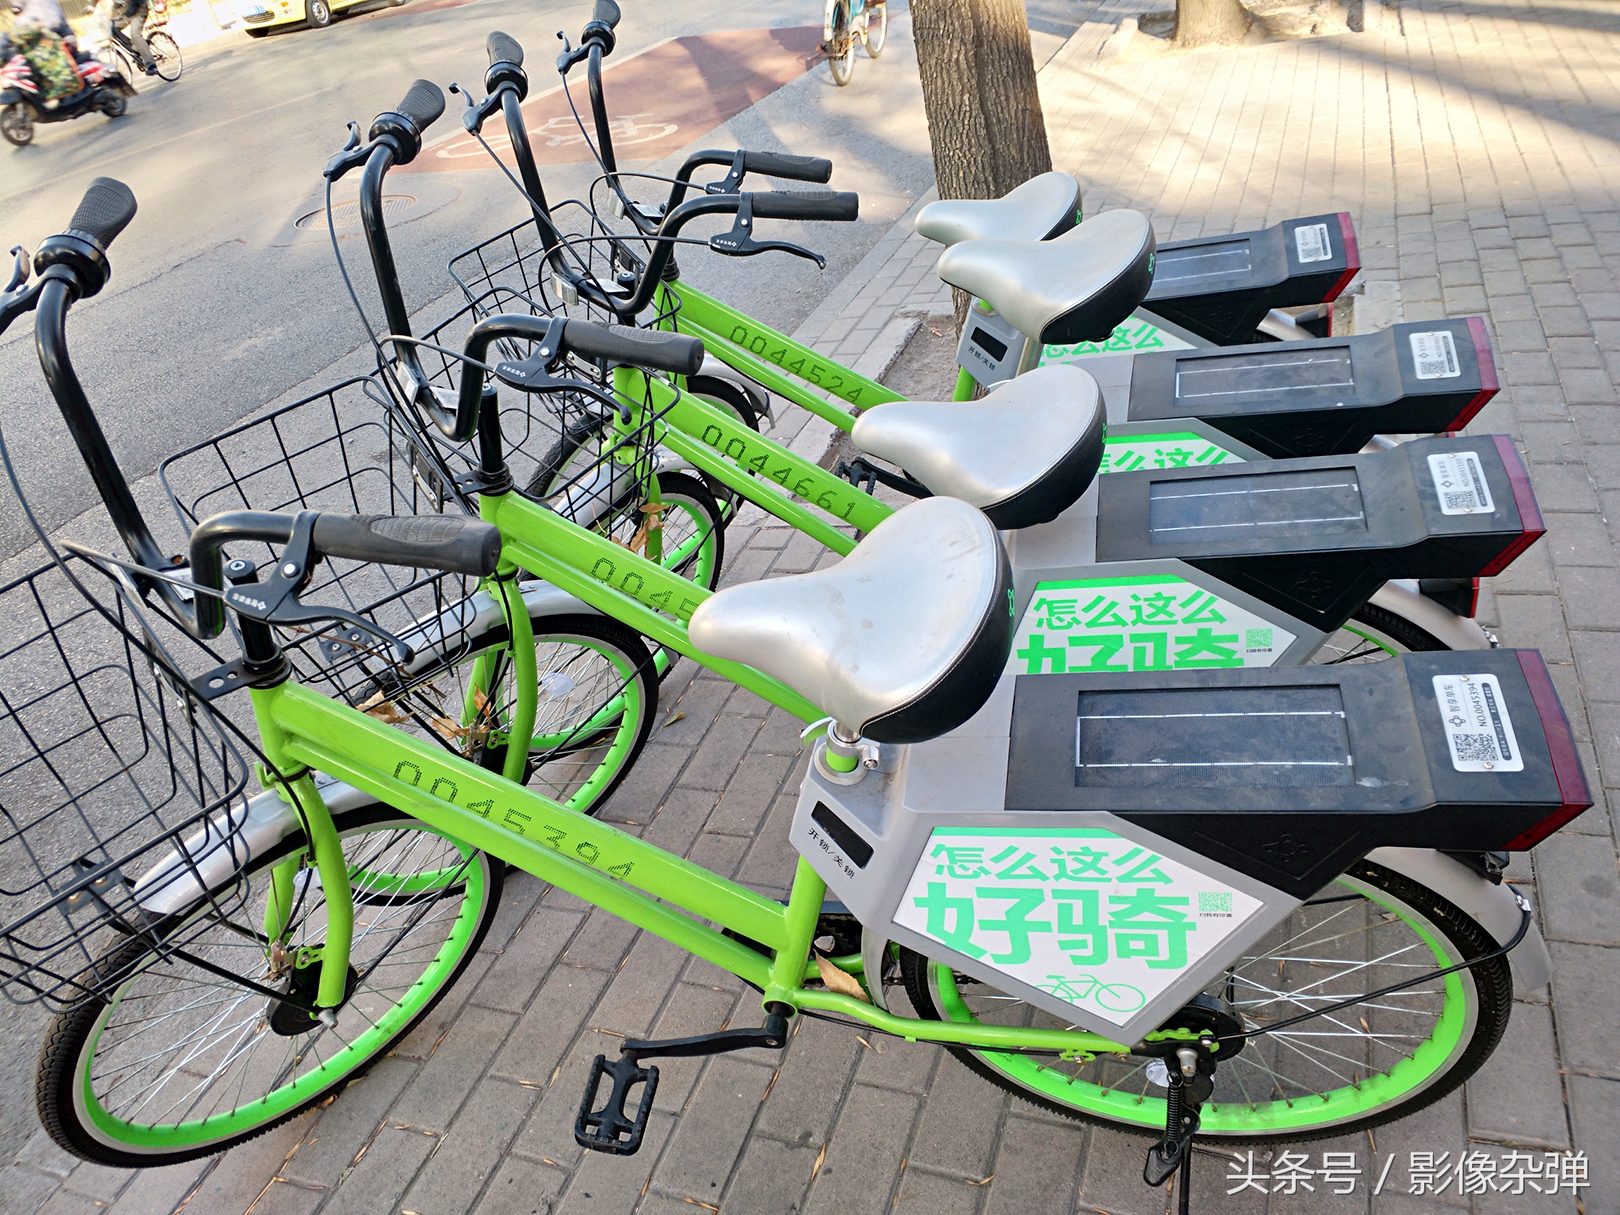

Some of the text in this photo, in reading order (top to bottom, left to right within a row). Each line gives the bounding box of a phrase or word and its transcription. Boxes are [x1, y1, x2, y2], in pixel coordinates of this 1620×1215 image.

[729, 325, 864, 404] 0044524
[701, 424, 856, 519] 0044661
[591, 557, 699, 618] 0045
[1033, 590, 1227, 630] 怎么这么
[1443, 683, 1461, 713] 智享单车
[1467, 682, 1488, 727] NO.0045394
[393, 760, 635, 880] 0045394
[808, 827, 856, 879] 开锁/关锁
[930, 843, 1175, 885] 怎么这么
[913, 881, 1197, 970] 好骑
